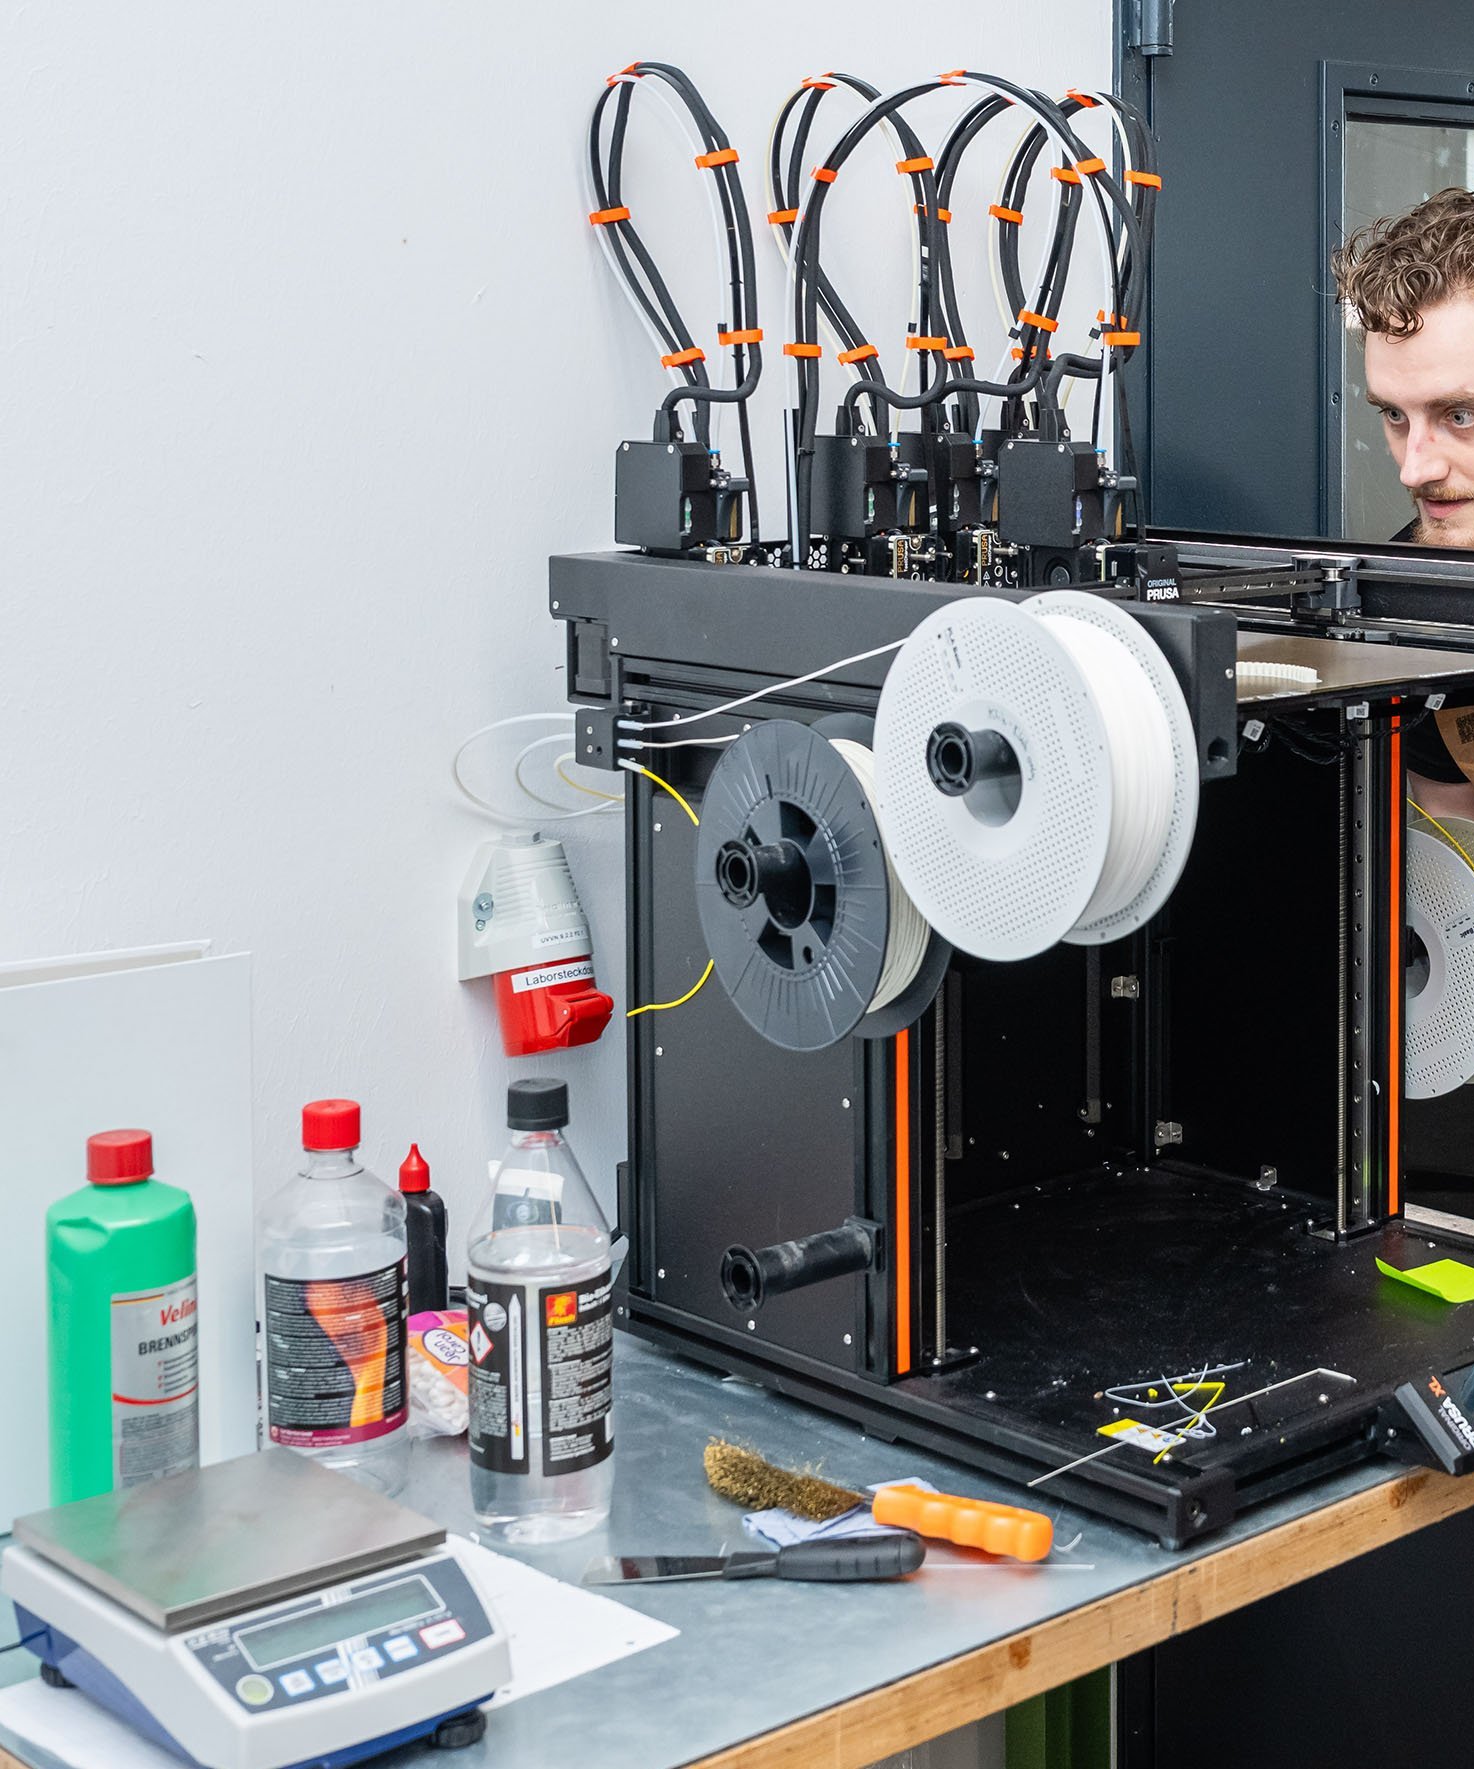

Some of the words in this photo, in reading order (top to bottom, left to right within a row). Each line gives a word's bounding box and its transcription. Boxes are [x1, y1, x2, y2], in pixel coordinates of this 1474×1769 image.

[1146, 587, 1180, 601] PRUSA
[1147, 578, 1177, 588] ORIGINAL
[434, 1340, 461, 1362] Jean
[1428, 1375, 1447, 1398] XL
[1438, 1405, 1472, 1450] ORIGINAL
